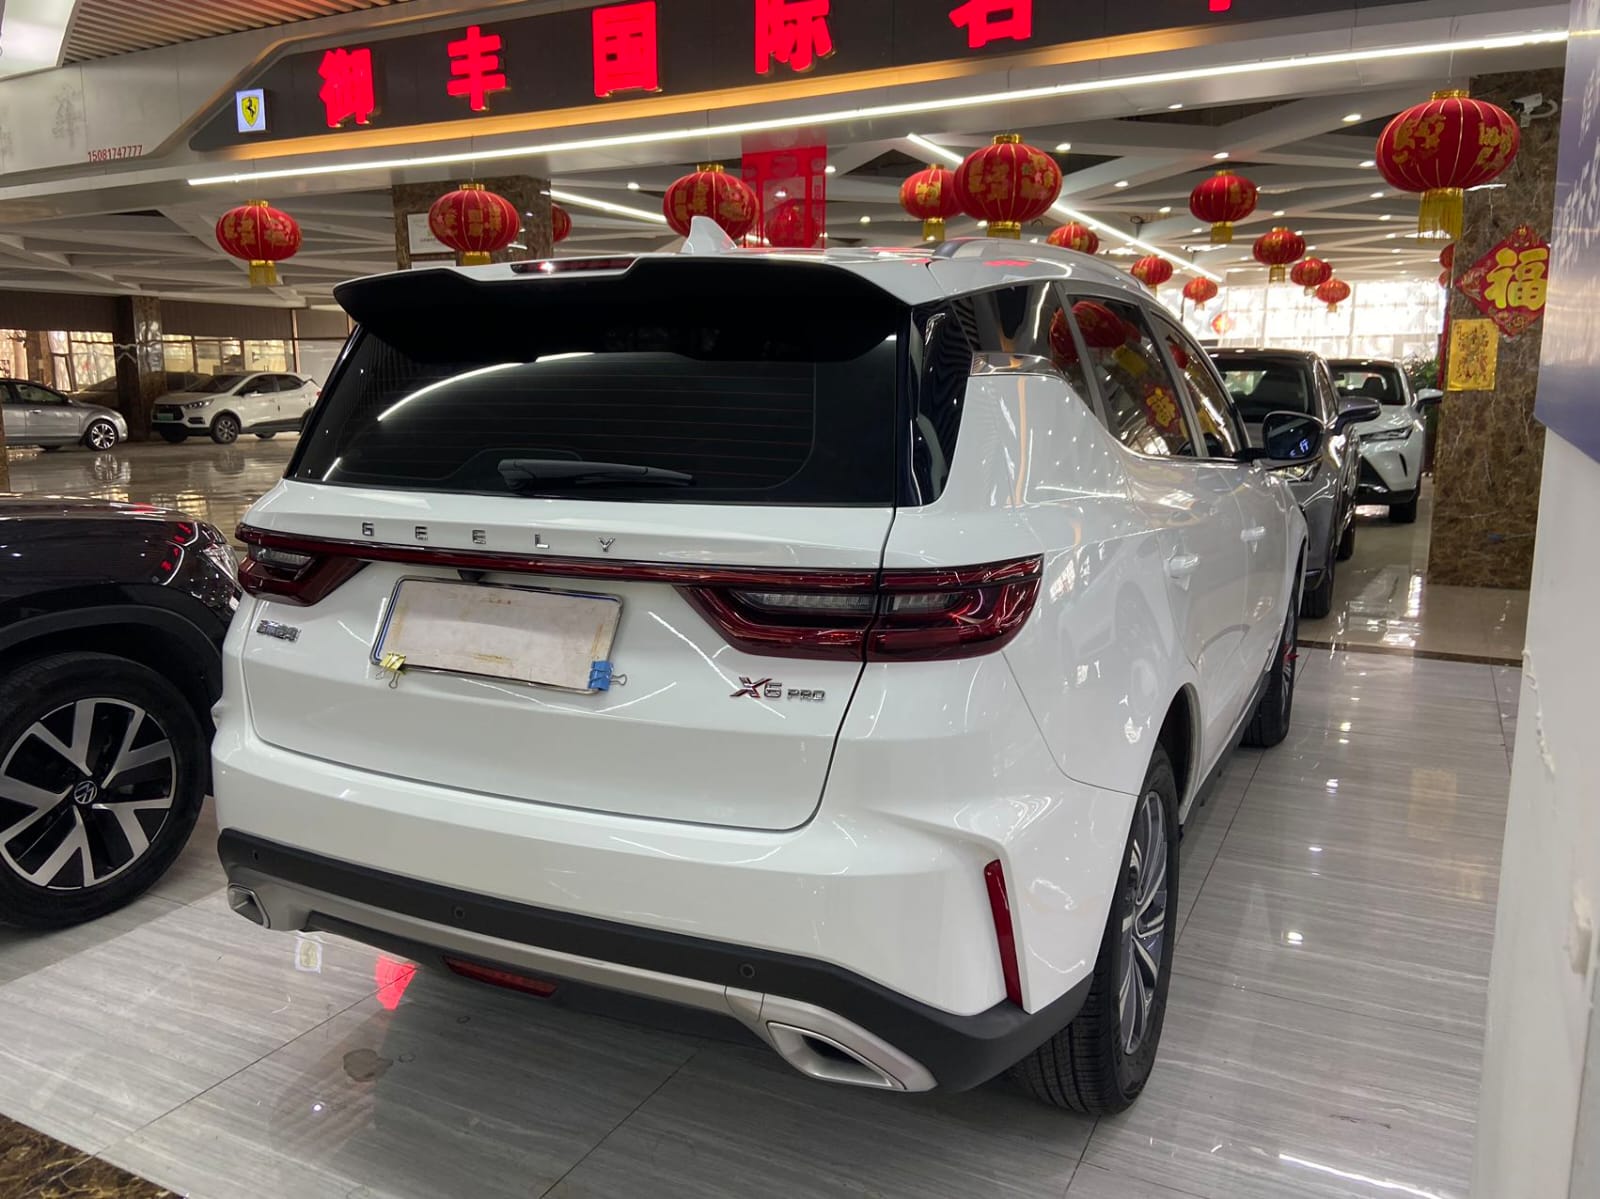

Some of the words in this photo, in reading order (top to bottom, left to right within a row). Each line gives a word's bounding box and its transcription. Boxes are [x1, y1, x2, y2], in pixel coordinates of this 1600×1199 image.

[317, 0, 1232, 128] 御丰国际名
[1484, 247, 1549, 311] 福
[361, 521, 616, 553] GEELY
[729, 676, 783, 699] X6
[786, 688, 827, 702] PRO
